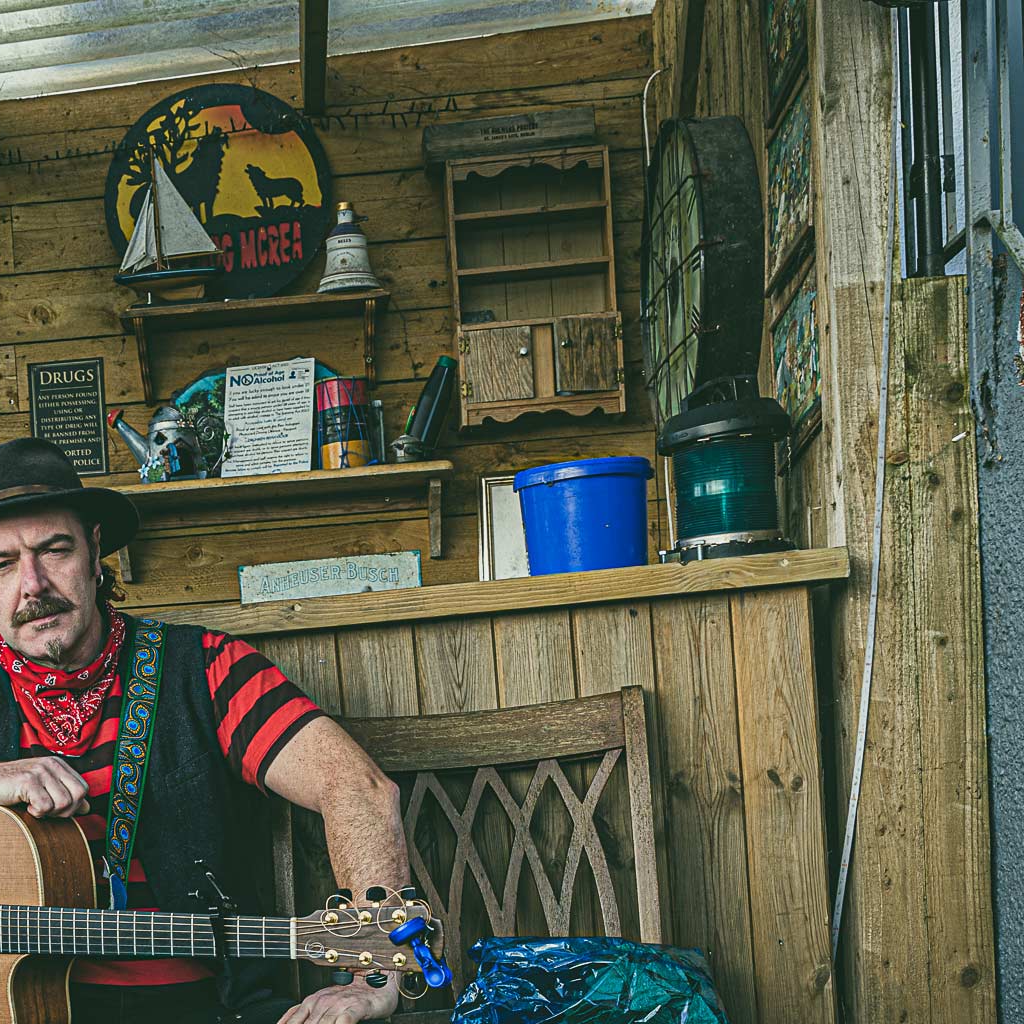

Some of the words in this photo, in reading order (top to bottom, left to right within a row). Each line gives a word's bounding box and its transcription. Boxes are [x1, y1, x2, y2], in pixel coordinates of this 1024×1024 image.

[240, 221, 303, 269] MCREA
[40, 369, 94, 385] DRUGS
[253, 375, 285, 385] Alcohol
[65, 449, 92, 457] ORTED
[73, 458, 101, 466] POLICE
[260, 562, 399, 594] ANHEUSER-BUSCH
